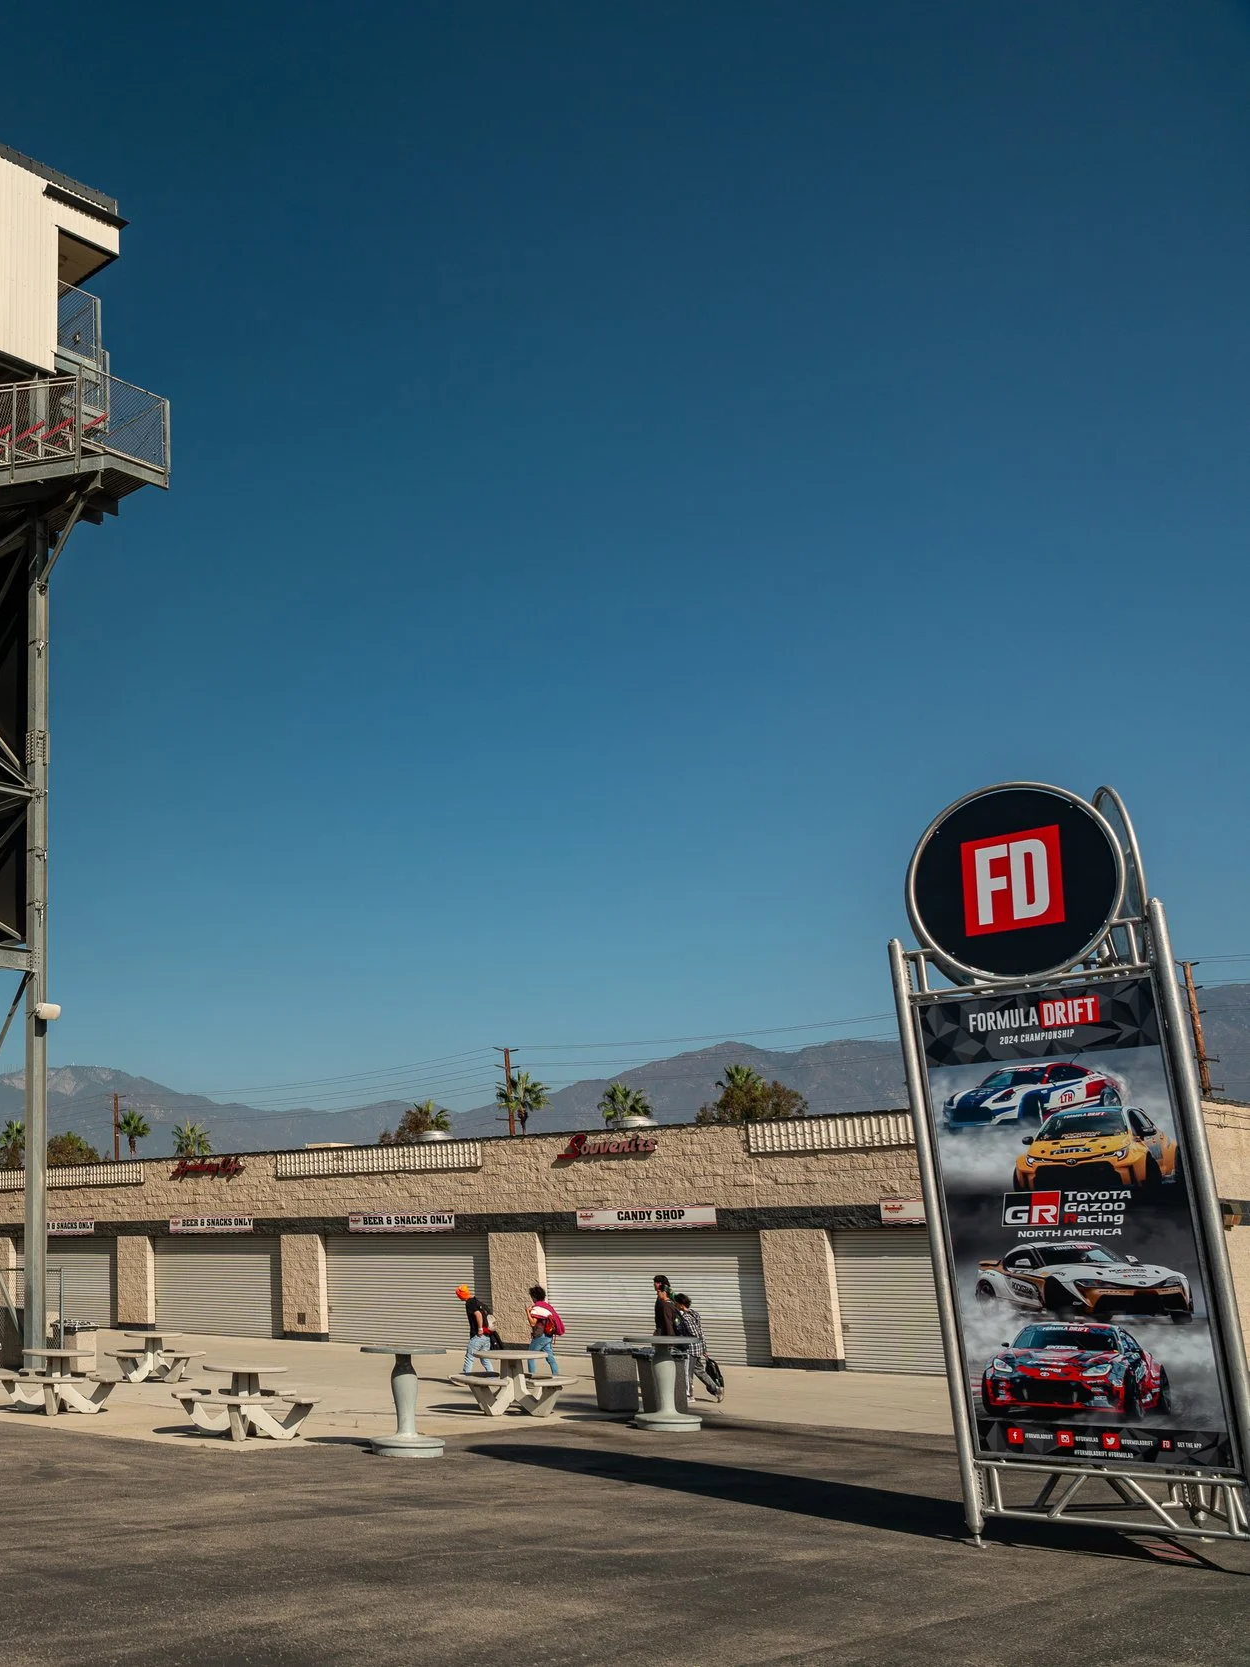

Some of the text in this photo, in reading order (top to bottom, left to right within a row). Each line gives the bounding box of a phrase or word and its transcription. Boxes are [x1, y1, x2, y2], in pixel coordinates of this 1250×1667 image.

[975, 839, 1050, 925] FD
[968, 998, 1094, 1033] FORMULA DRIFT
[999, 1029, 1075, 1045] 2024 CHAMPIONSHIP
[1060, 1091, 1073, 1104] LTH
[557, 1134, 658, 1160] Souvenirs
[1064, 1190, 1131, 1201] TOYOTA
[1064, 1202, 1126, 1212] GAZOO
[363, 1216, 384, 1225] BEER
[386, 1216, 392, 1224] &
[395, 1215, 428, 1225] SNACKS
[430, 1215, 453, 1224] ONLY
[617, 1209, 685, 1221] CANDY SHOP
[1004, 1205, 1058, 1224] GR
[1064, 1212, 1124, 1225] Racing
[78, 1221, 94, 1229] ONLY
[182, 1218, 199, 1227] BEER
[200, 1218, 204, 1226] &
[206, 1217, 232, 1226] SNACKS
[233, 1217, 253, 1226] ONLY
[1017, 1228, 1122, 1238] NORTH AMERICA
